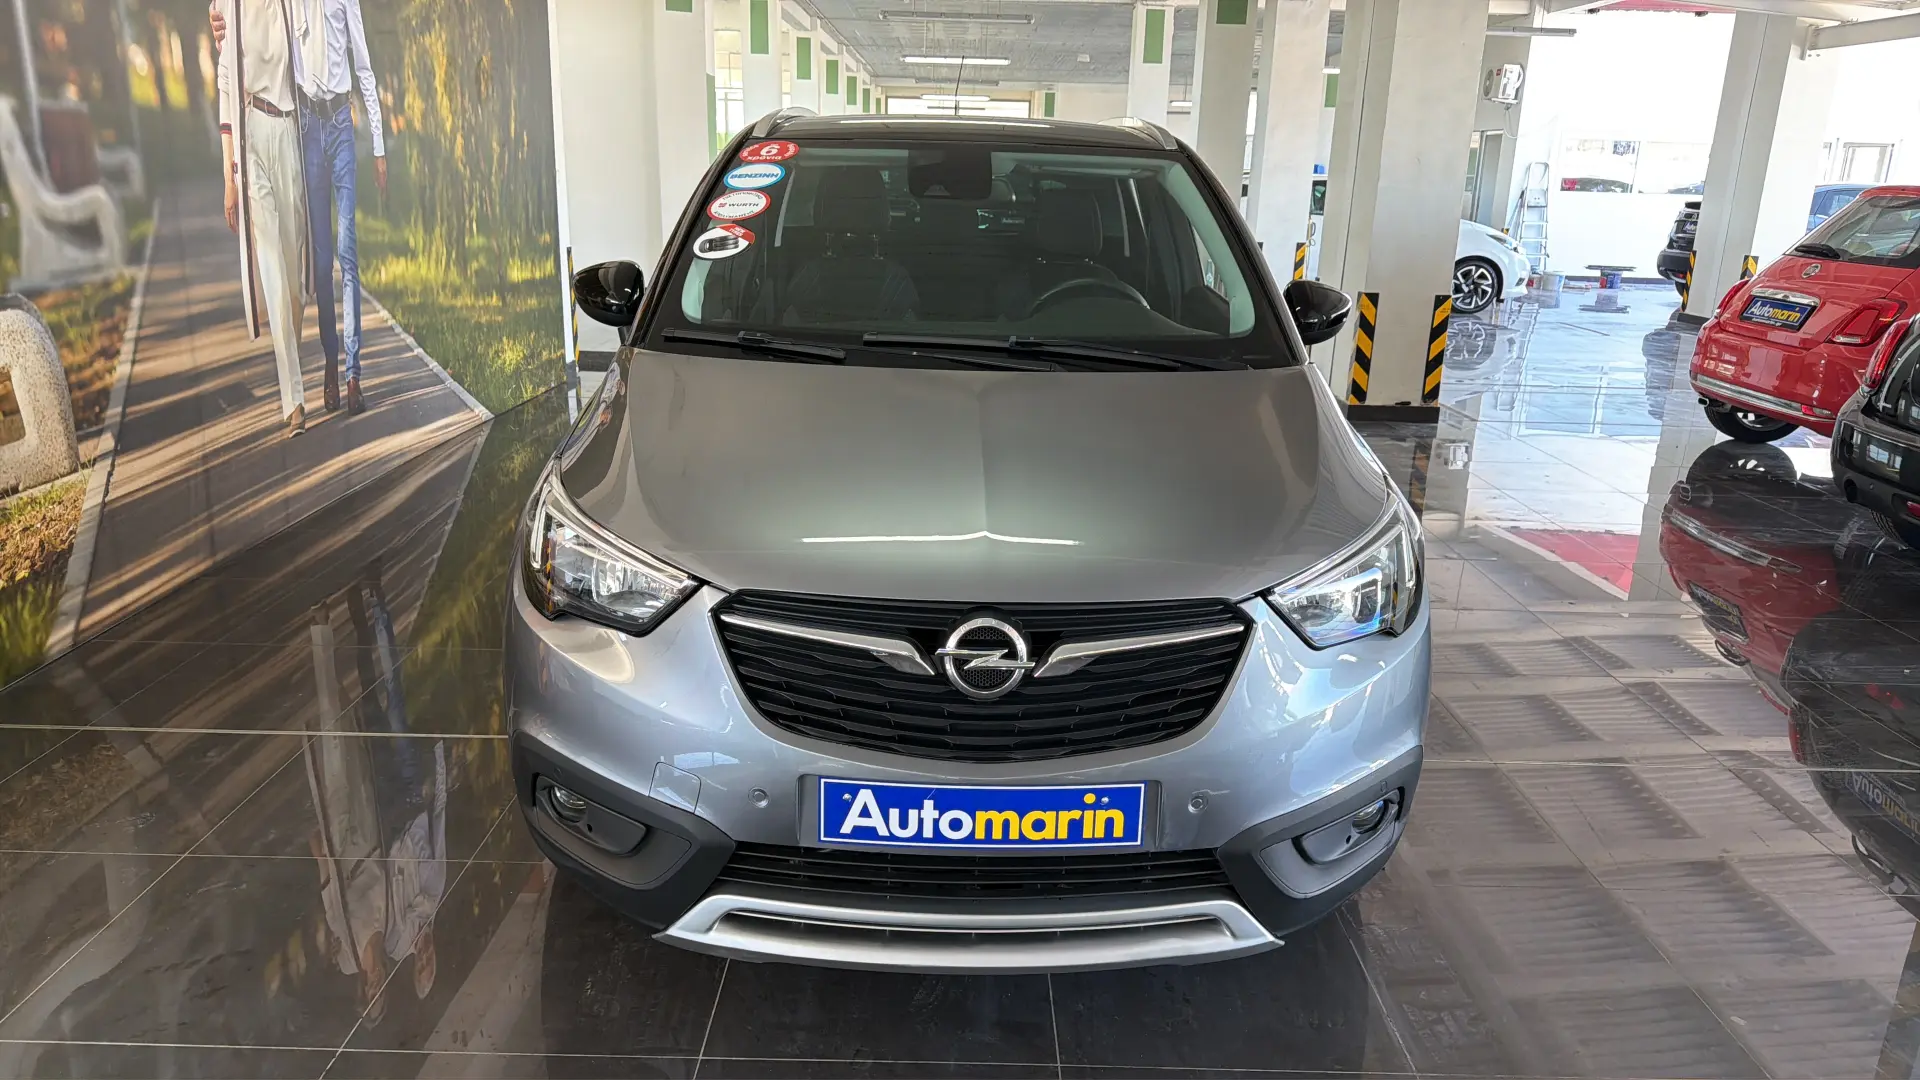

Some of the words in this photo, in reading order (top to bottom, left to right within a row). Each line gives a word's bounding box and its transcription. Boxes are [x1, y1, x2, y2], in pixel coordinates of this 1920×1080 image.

[760, 146, 780, 155] 6
[1748, 301, 1800, 322] Automarin
[839, 788, 1124, 840] Automarin
